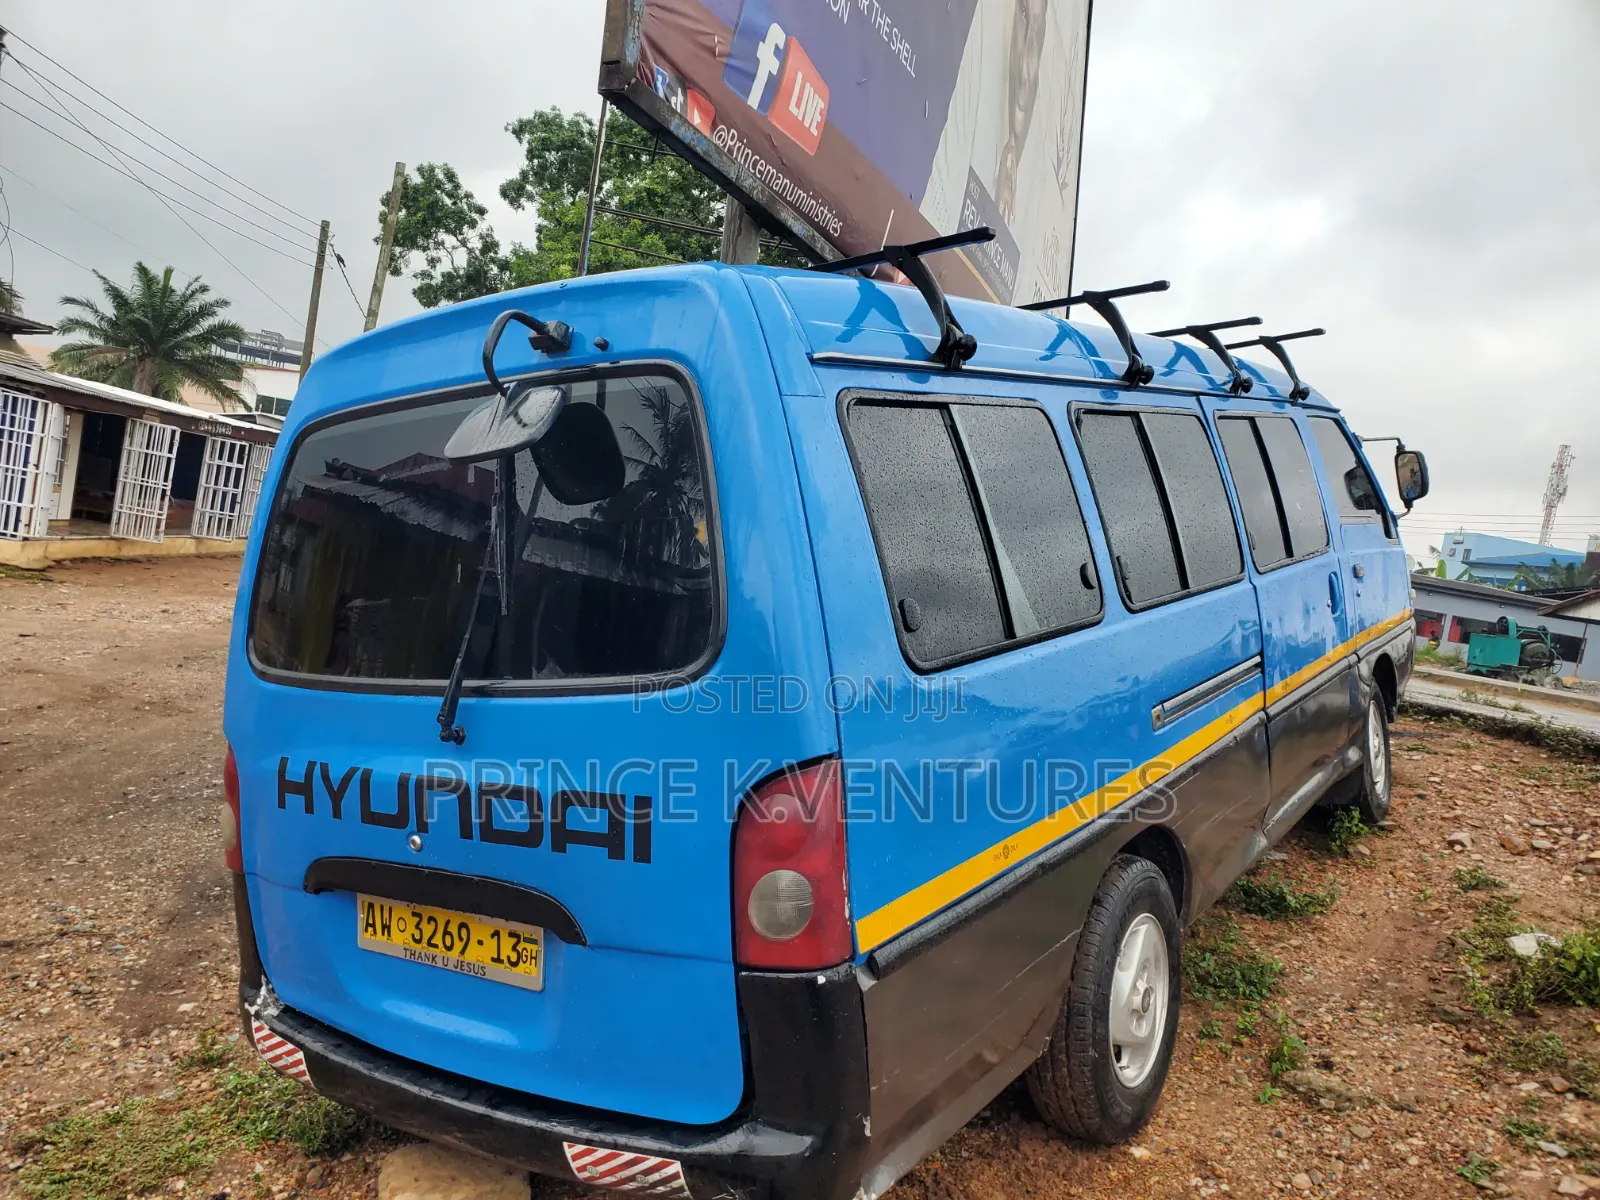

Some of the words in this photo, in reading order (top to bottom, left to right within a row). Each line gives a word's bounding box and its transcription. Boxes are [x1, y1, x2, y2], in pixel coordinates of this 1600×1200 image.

[871, 0, 892, 42] THE
[890, 27, 917, 78] SHELL
[788, 71, 825, 137] LIVE
[713, 124, 844, 239] @Princemanuministries
[277, 756, 652, 864] HYUNDAI
[364, 902, 393, 938] AW
[520, 946, 538, 968] GH
[402, 947, 438, 965] THANK
[442, 957, 450, 968] U
[453, 958, 487, 977] JESUS
